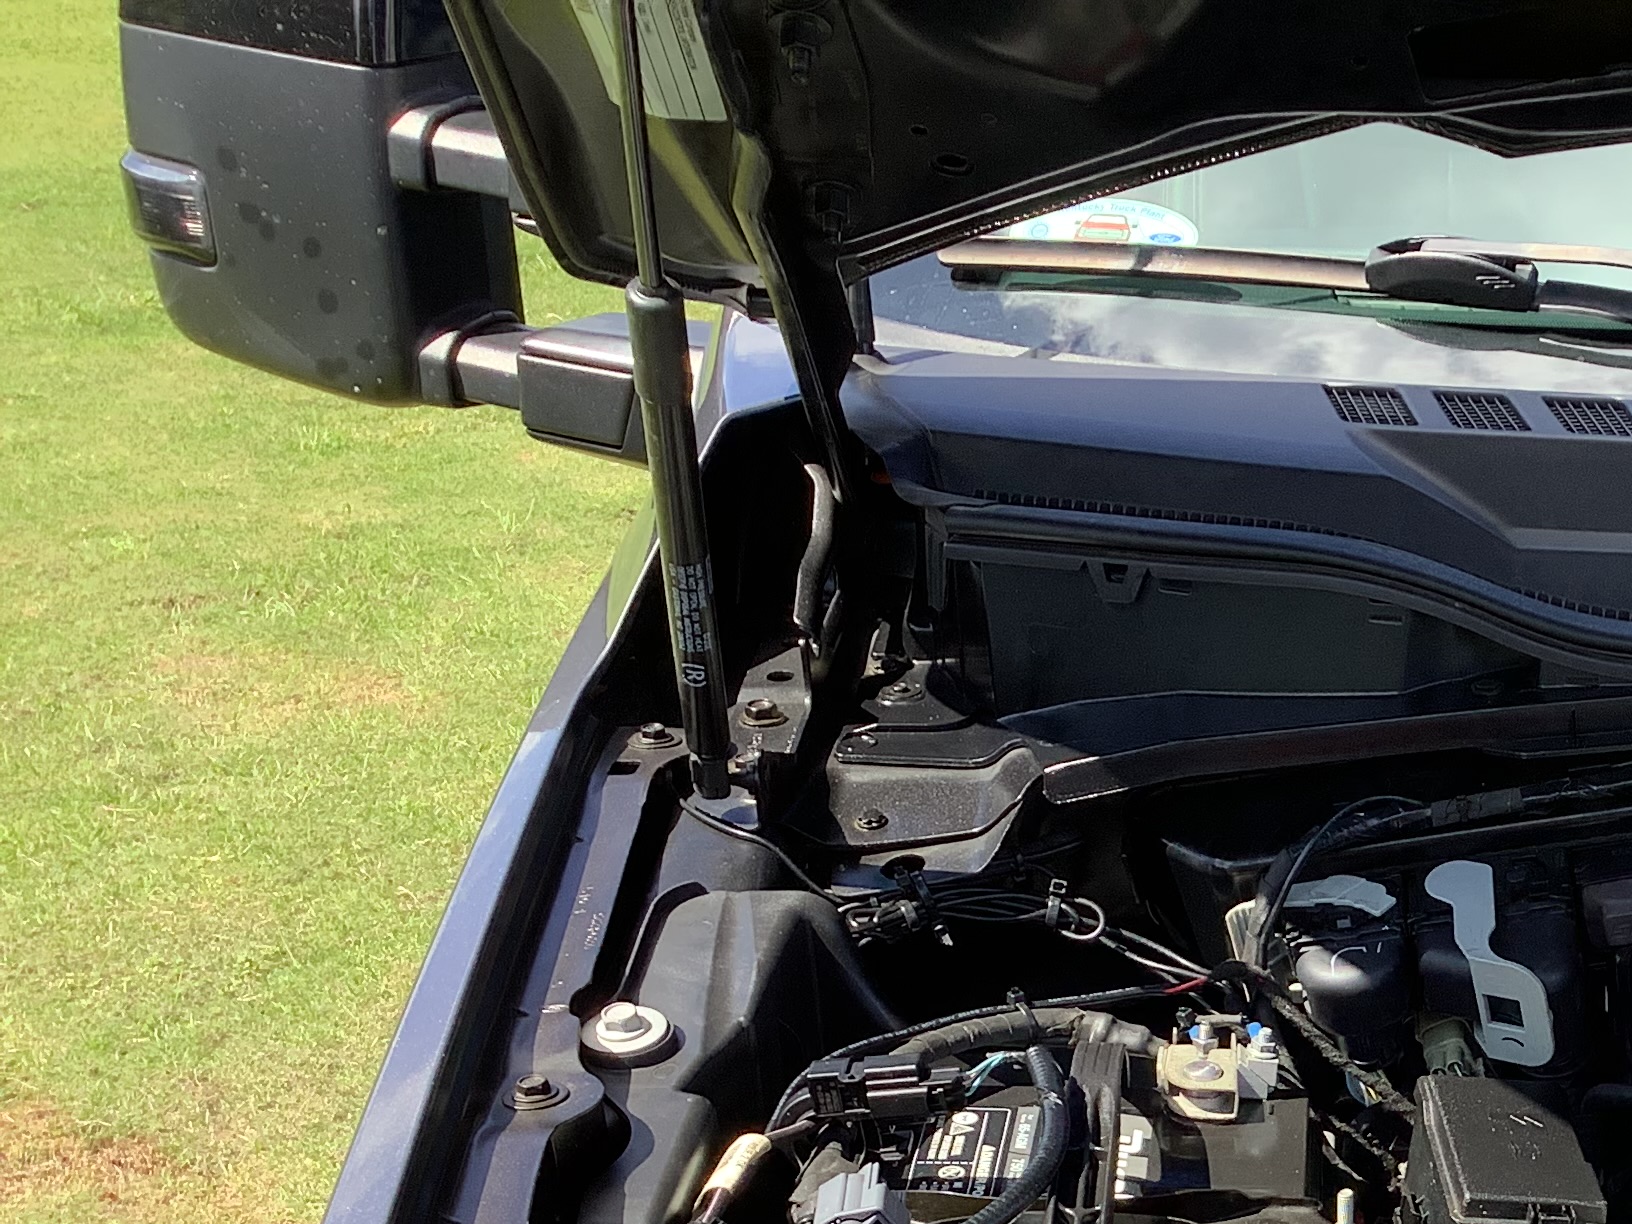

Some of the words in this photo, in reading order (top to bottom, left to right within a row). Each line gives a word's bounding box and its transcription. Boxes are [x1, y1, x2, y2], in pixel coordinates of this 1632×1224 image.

[1110, 203, 1137, 213] Truck
[1141, 206, 1166, 219] Plant
[681, 663, 707, 687] (R)
